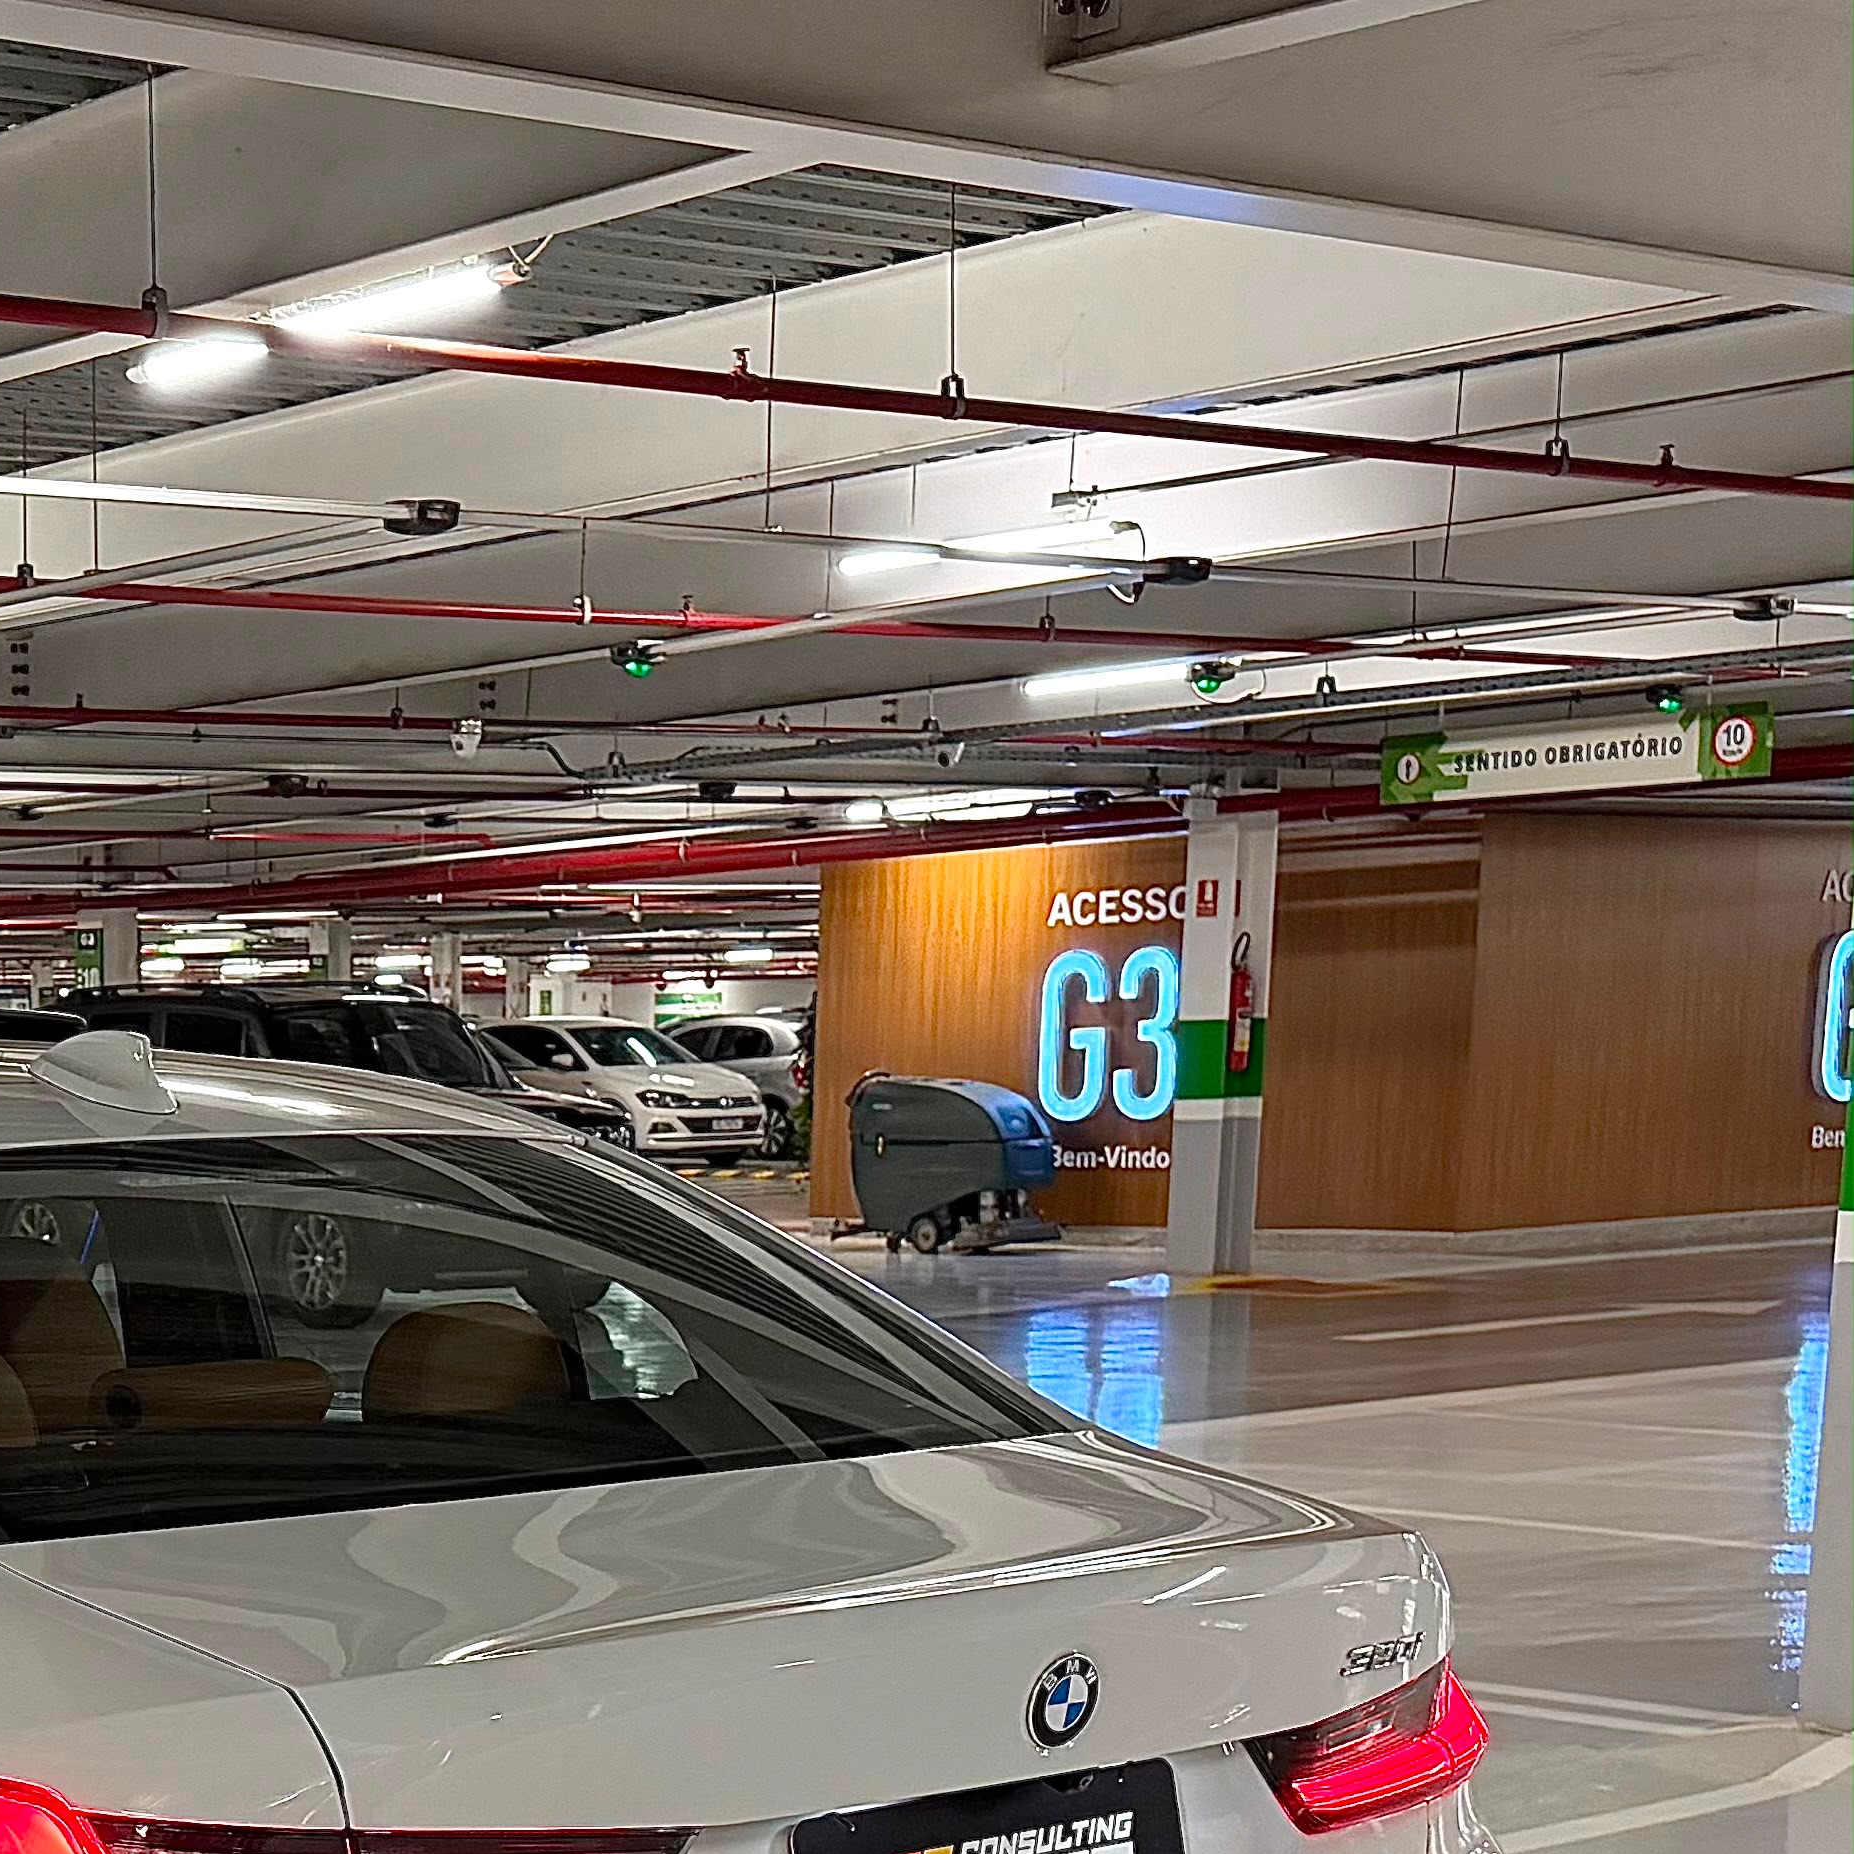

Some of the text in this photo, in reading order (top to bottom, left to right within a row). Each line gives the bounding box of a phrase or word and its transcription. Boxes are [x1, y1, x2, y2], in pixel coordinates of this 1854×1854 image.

[1454, 732, 1683, 773] SENTIDO OBRIGATÓRIO
[1723, 724, 1745, 747] 10
[1038, 945, 1179, 1122] G3
